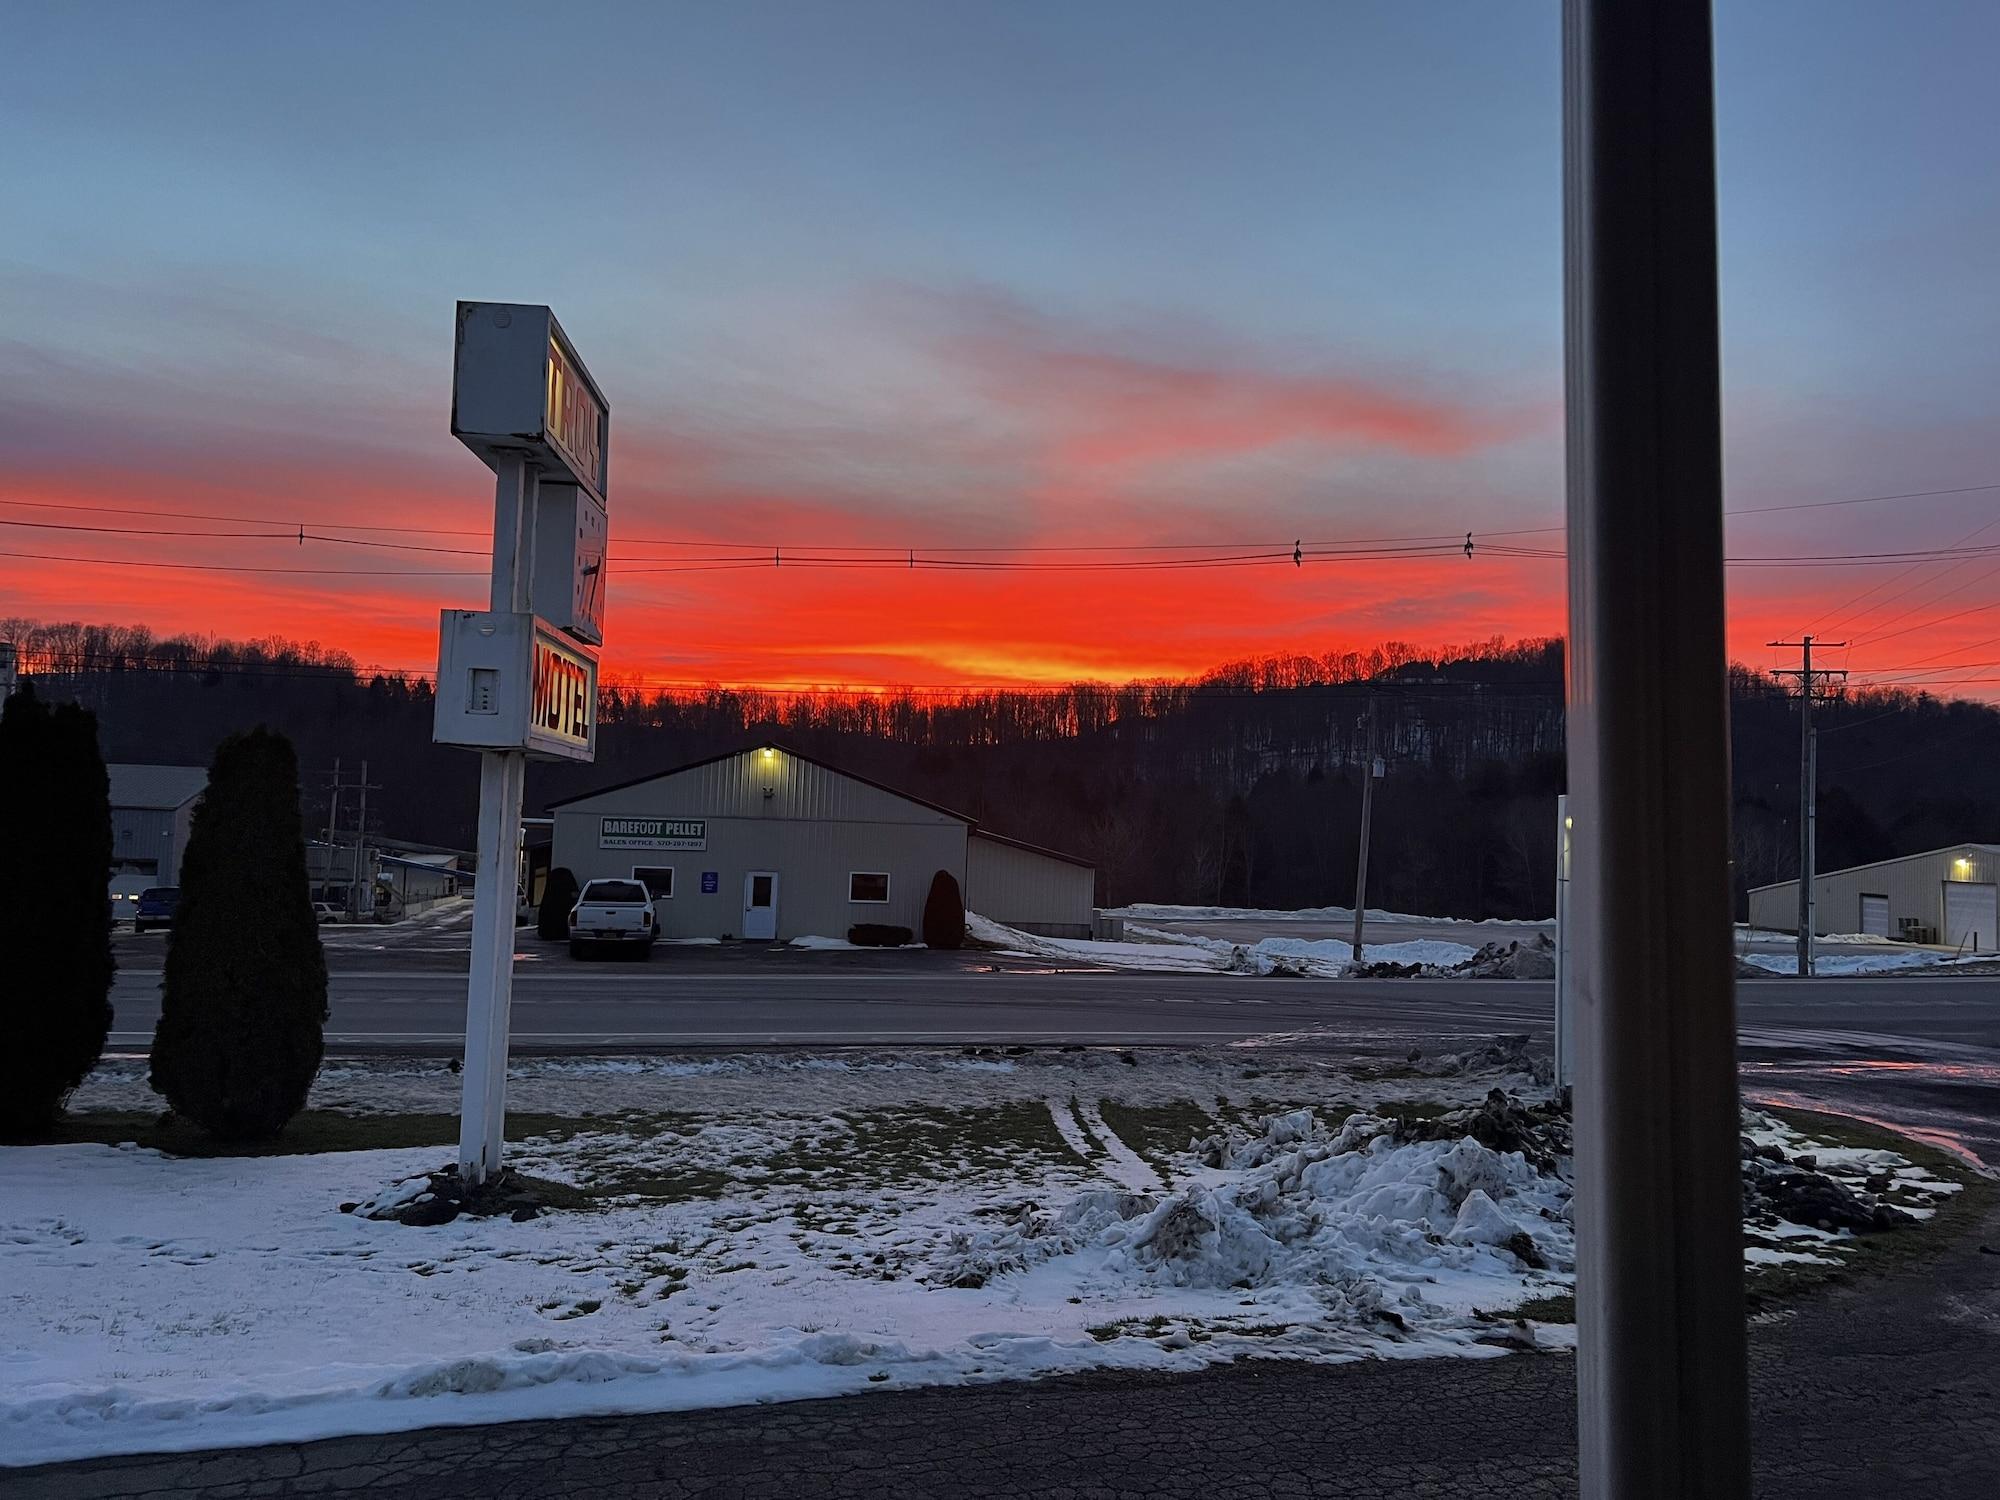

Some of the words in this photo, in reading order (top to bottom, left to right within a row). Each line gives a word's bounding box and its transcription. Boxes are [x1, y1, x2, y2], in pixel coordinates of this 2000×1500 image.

[531, 643, 588, 739] MOTEL
[604, 821, 662, 834] BAREFOOT
[666, 823, 704, 835] PELLET
